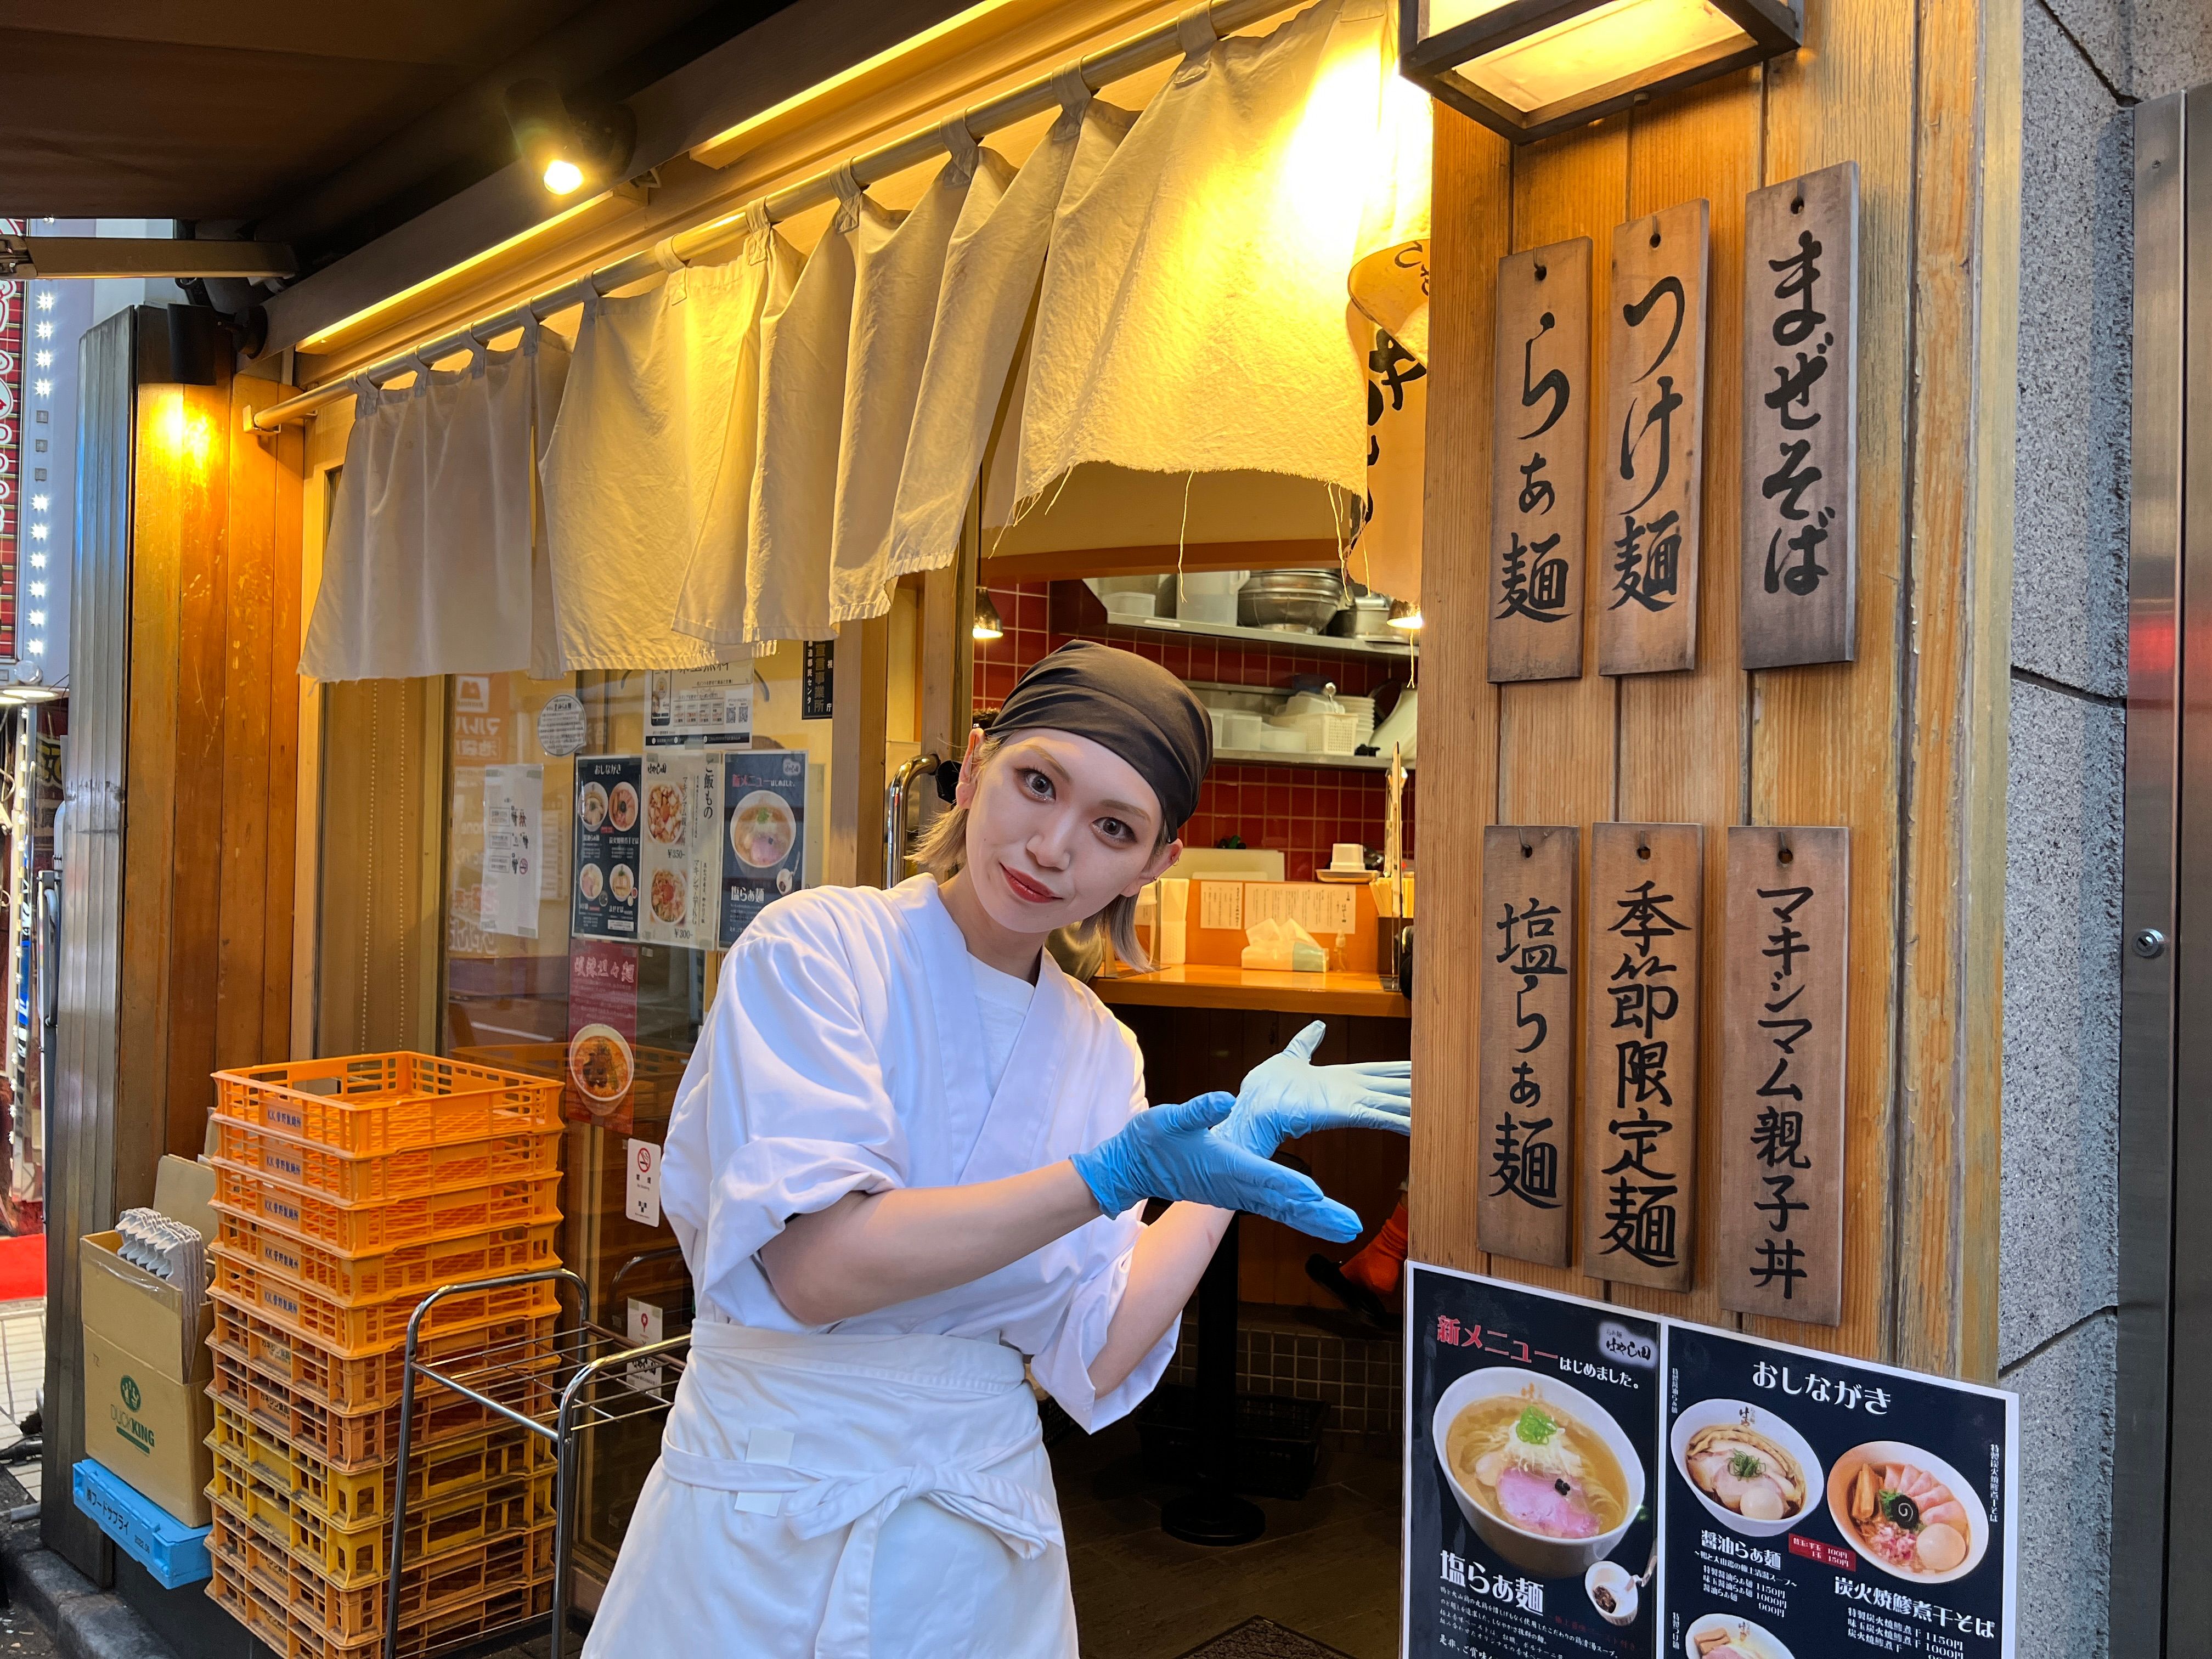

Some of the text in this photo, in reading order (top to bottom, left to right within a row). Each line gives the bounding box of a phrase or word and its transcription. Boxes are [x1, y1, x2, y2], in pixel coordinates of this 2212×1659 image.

[1607, 275, 1685, 612] つけ麺
[1762, 230, 1836, 596] まぜそば
[1488, 898, 1568, 1209] 塩らぁ麺
[1599, 880, 1692, 1267] 季節限定麺
[1750, 886, 1814, 1299] マキシマム親子丼
[1437, 1315, 1639, 1389] 新メニュー はじめました。
[1752, 1361, 1891, 1415] おしながき
[1440, 1549, 1544, 1616] 塩らぁ麺
[1701, 1530, 1781, 1571] 醤油らぁ麺
